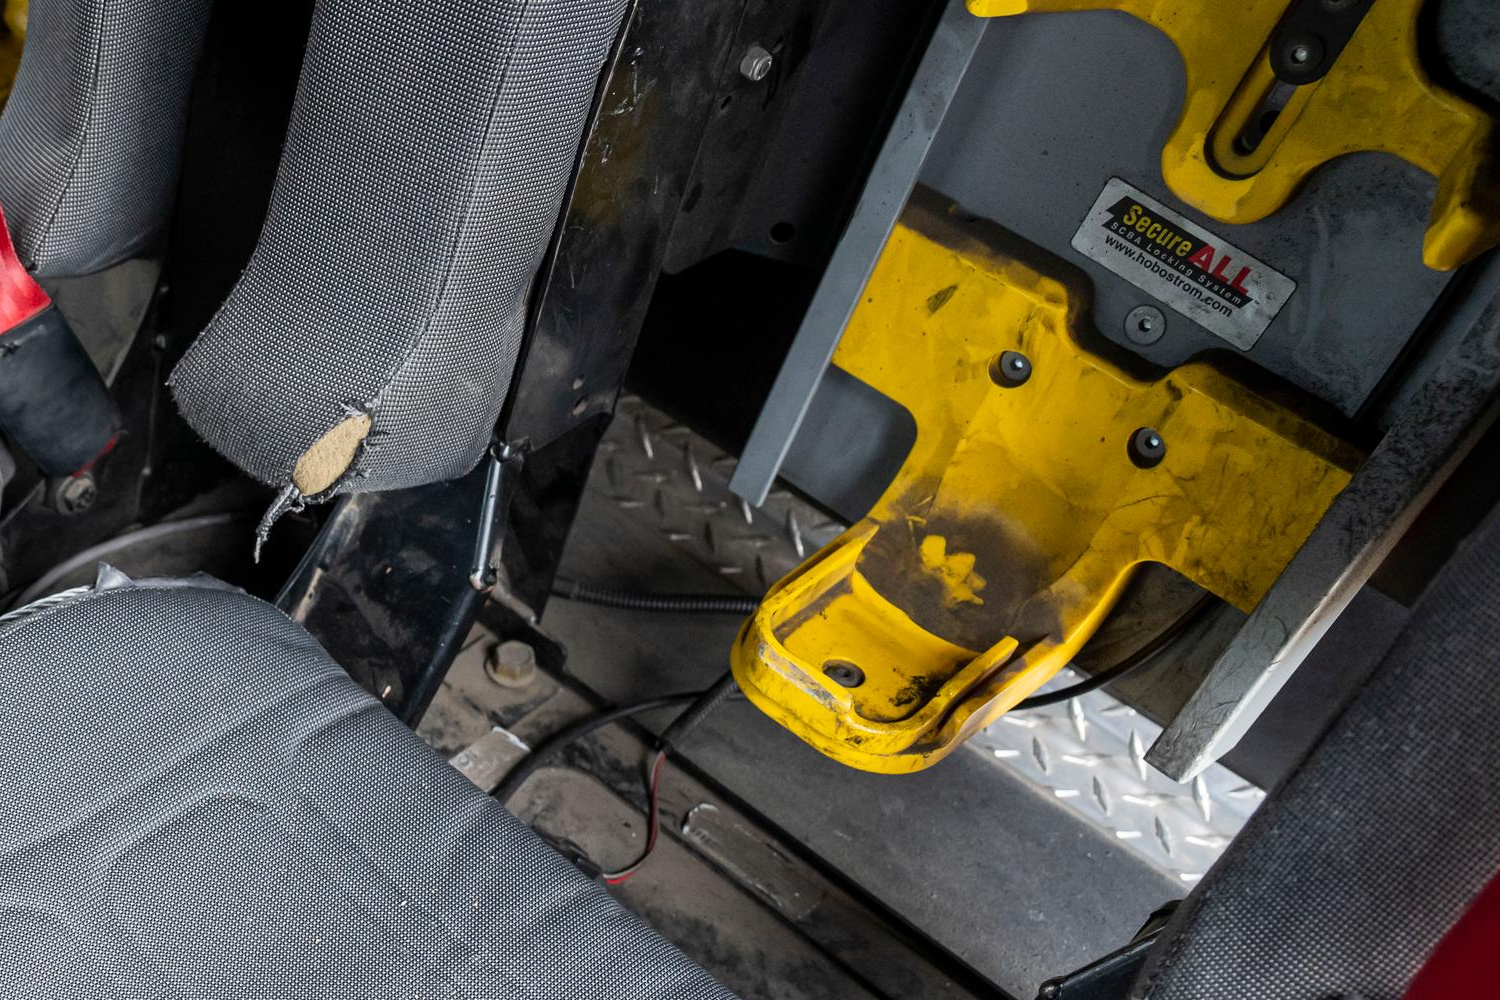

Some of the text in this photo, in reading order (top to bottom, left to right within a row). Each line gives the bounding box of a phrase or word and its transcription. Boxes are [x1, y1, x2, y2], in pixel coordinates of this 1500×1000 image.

[1104, 234, 1233, 317] www.hobostrom.com
[1111, 221, 1242, 305] SCBA Locking System
